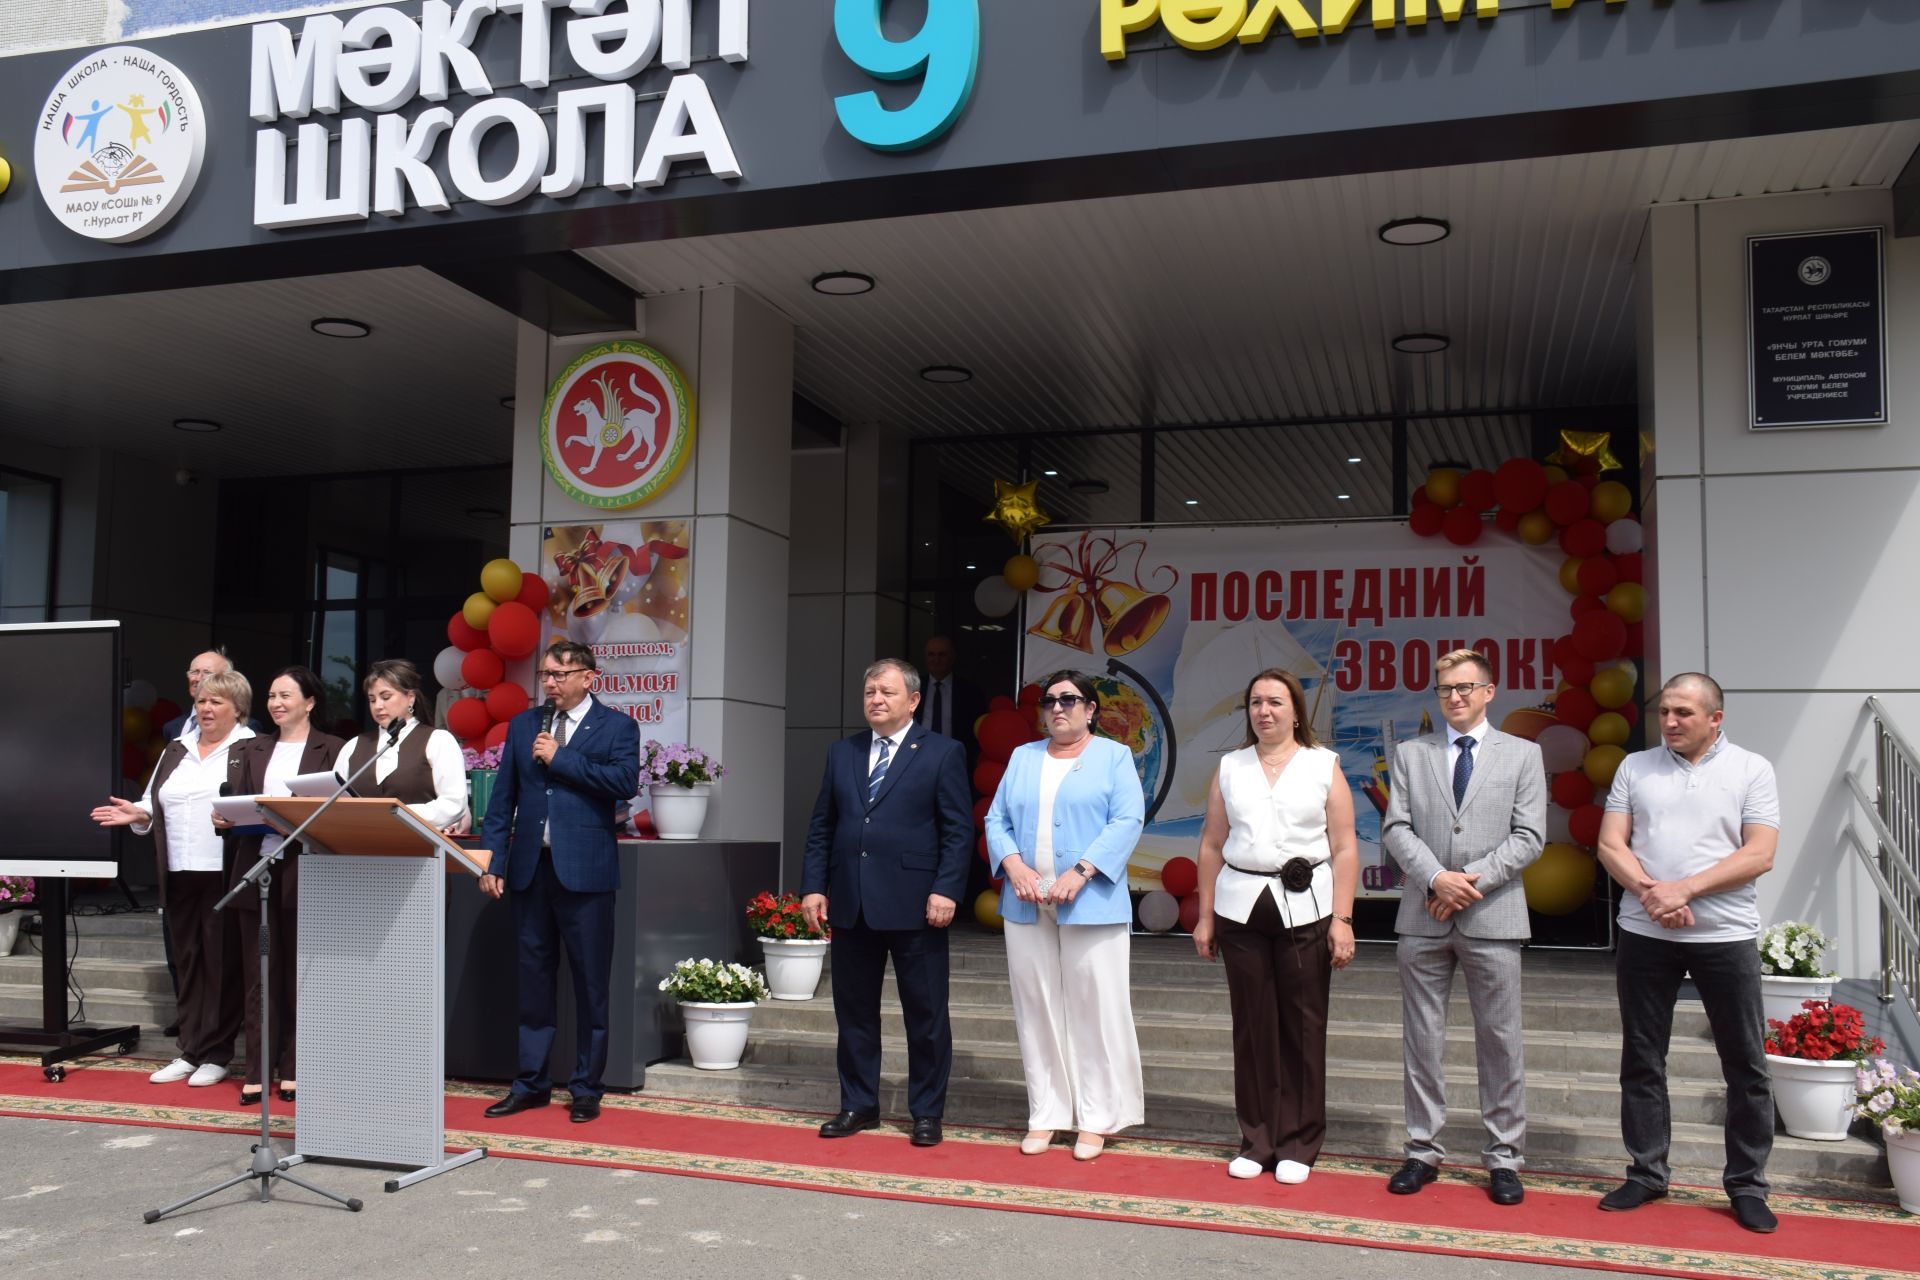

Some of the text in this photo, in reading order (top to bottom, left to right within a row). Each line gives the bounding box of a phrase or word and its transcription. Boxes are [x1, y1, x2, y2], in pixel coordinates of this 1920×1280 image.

[834, 0, 980, 151] 9
[43, 92, 67, 131] НАША
[67, 58, 108, 89] ШКОЛА
[123, 55, 156, 75] НАША
[156, 70, 189, 132] ГОРДОСТЬ
[254, 74, 743, 230] ШКОЛА
[65, 194, 162, 214] МАОУ «СОШ» № 9
[83, 211, 143, 228] г.Нурлат РТ
[1762, 301, 1871, 314] ТАТАРСТАН РЕСПУБЛИКАСЫ
[1783, 313, 1812, 321] НУРЛАТ
[1801, 340, 1824, 349] УРТА
[1828, 338, 1867, 347] ГОМУМИ
[1775, 352, 1806, 361] БЕЛЕМ
[1772, 371, 1867, 383] МУНИЦИПАЛЬ АВТОНОМ
[1786, 383, 1818, 391] ГОМУМИ
[1787, 391, 1848, 400] УЧРЕЖДЕНИЕСЕ
[1189, 555, 1485, 628] ПОСЛЕДНИЙ
[590, 643, 675, 659] аздником,
[589, 667, 678, 694] бимая
